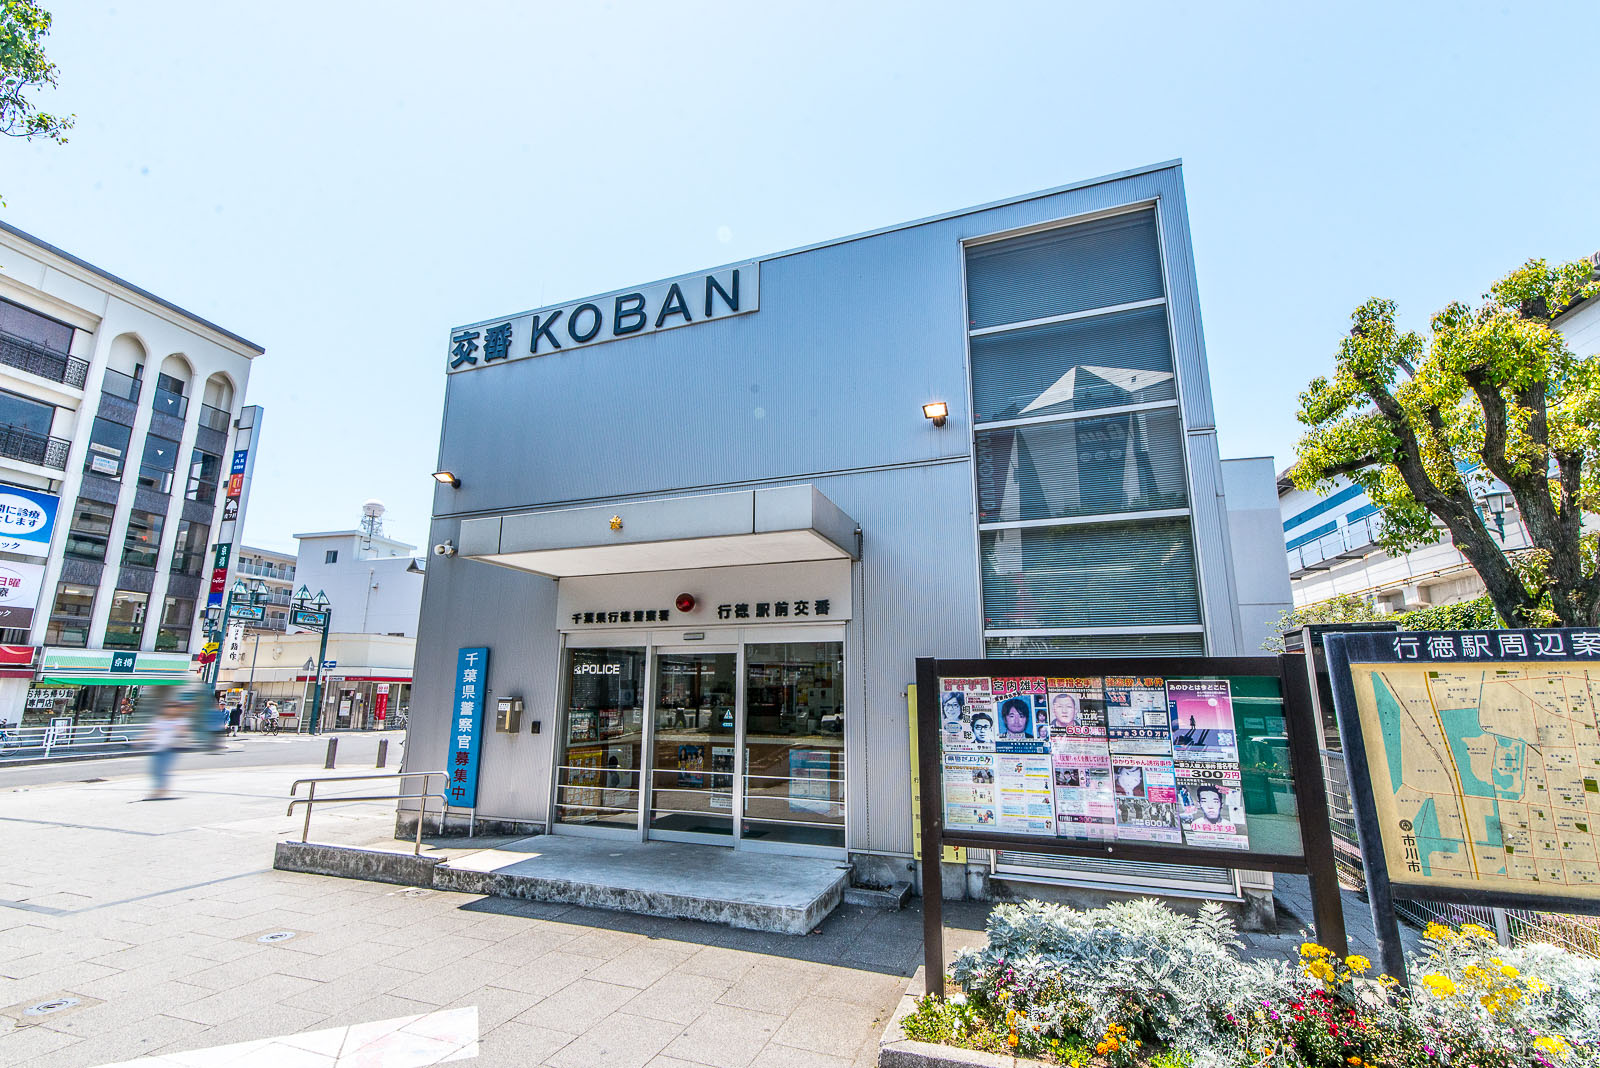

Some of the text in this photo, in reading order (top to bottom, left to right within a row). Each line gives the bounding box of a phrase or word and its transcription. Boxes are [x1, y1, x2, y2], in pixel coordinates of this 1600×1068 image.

[450, 269, 740, 369] 交番 KOBAN
[0, 514, 38, 527] します
[0, 576, 21, 588] 日曜
[571, 599, 831, 625] 千葉県行徳警察署 行徳駅前交番
[1392, 631, 1600, 660] 行徳駅周辺案
[582, 664, 621, 675] POLICE
[993, 680, 1046, 691] 宮内雄大
[451, 651, 480, 801] 千葉県警察官募集中
[1191, 770, 1241, 780] 300万円
[1400, 833, 1421, 873] 市川市
